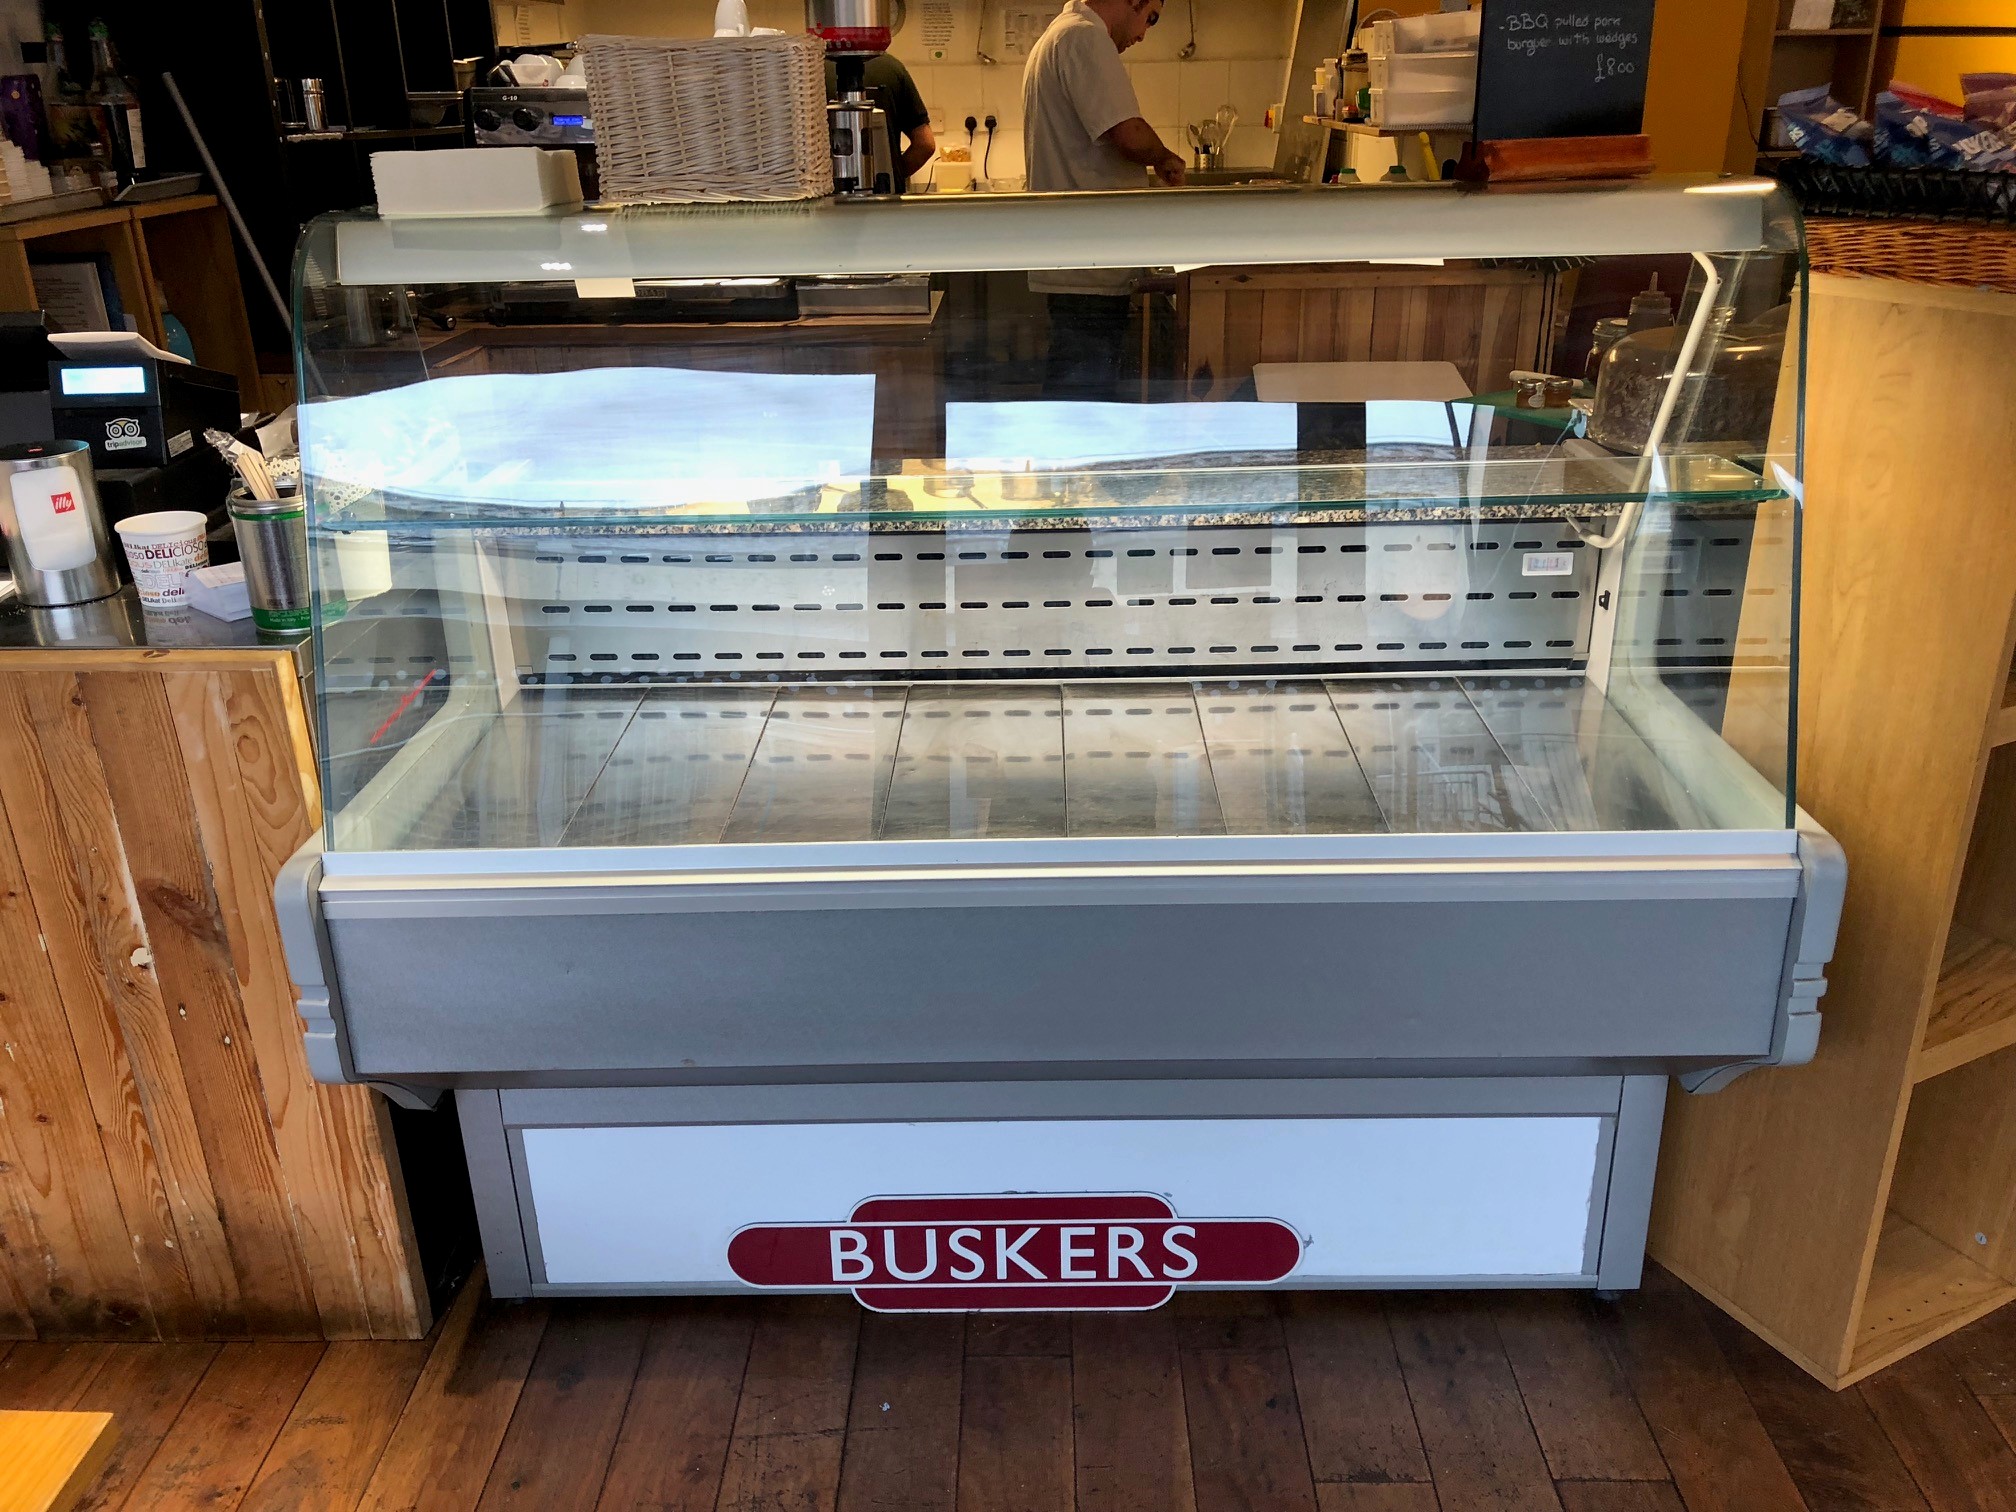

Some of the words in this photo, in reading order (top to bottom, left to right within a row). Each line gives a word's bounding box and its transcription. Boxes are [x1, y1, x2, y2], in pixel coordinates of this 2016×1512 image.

[1554, 14, 1589, 30] pulled
[1558, 33, 1590, 46] with
[1596, 32, 1638, 49] wedges
[107, 439, 143, 448] tripadvisor
[55, 496, 72, 510] illy
[145, 541, 204, 560] DELICIOSO
[829, 1226, 1198, 1281] BUSKERS
